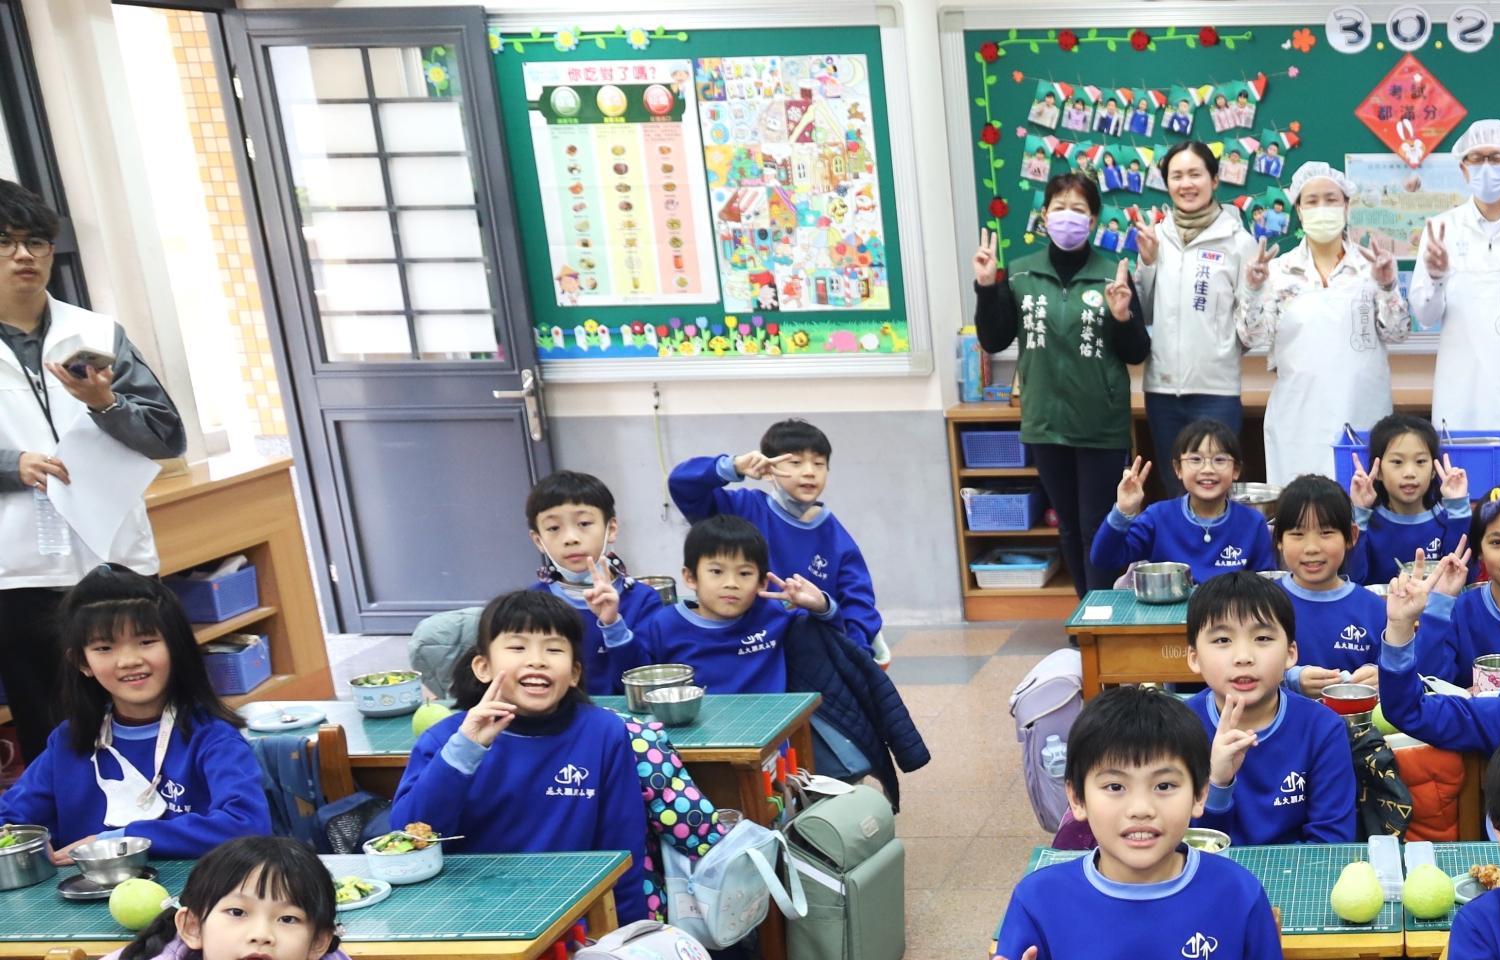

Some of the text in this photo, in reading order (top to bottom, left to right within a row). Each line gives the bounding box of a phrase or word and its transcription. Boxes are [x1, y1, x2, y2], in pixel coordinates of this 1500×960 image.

[1389, 84, 1427, 101] 考試
[1377, 105, 1438, 121] 都滿分
[1201, 252, 1222, 262] KMT
[1193, 263, 1211, 312] 洪佳君
[1035, 294, 1048, 348] 立法委員
[1079, 308, 1095, 358] 林姿佑
